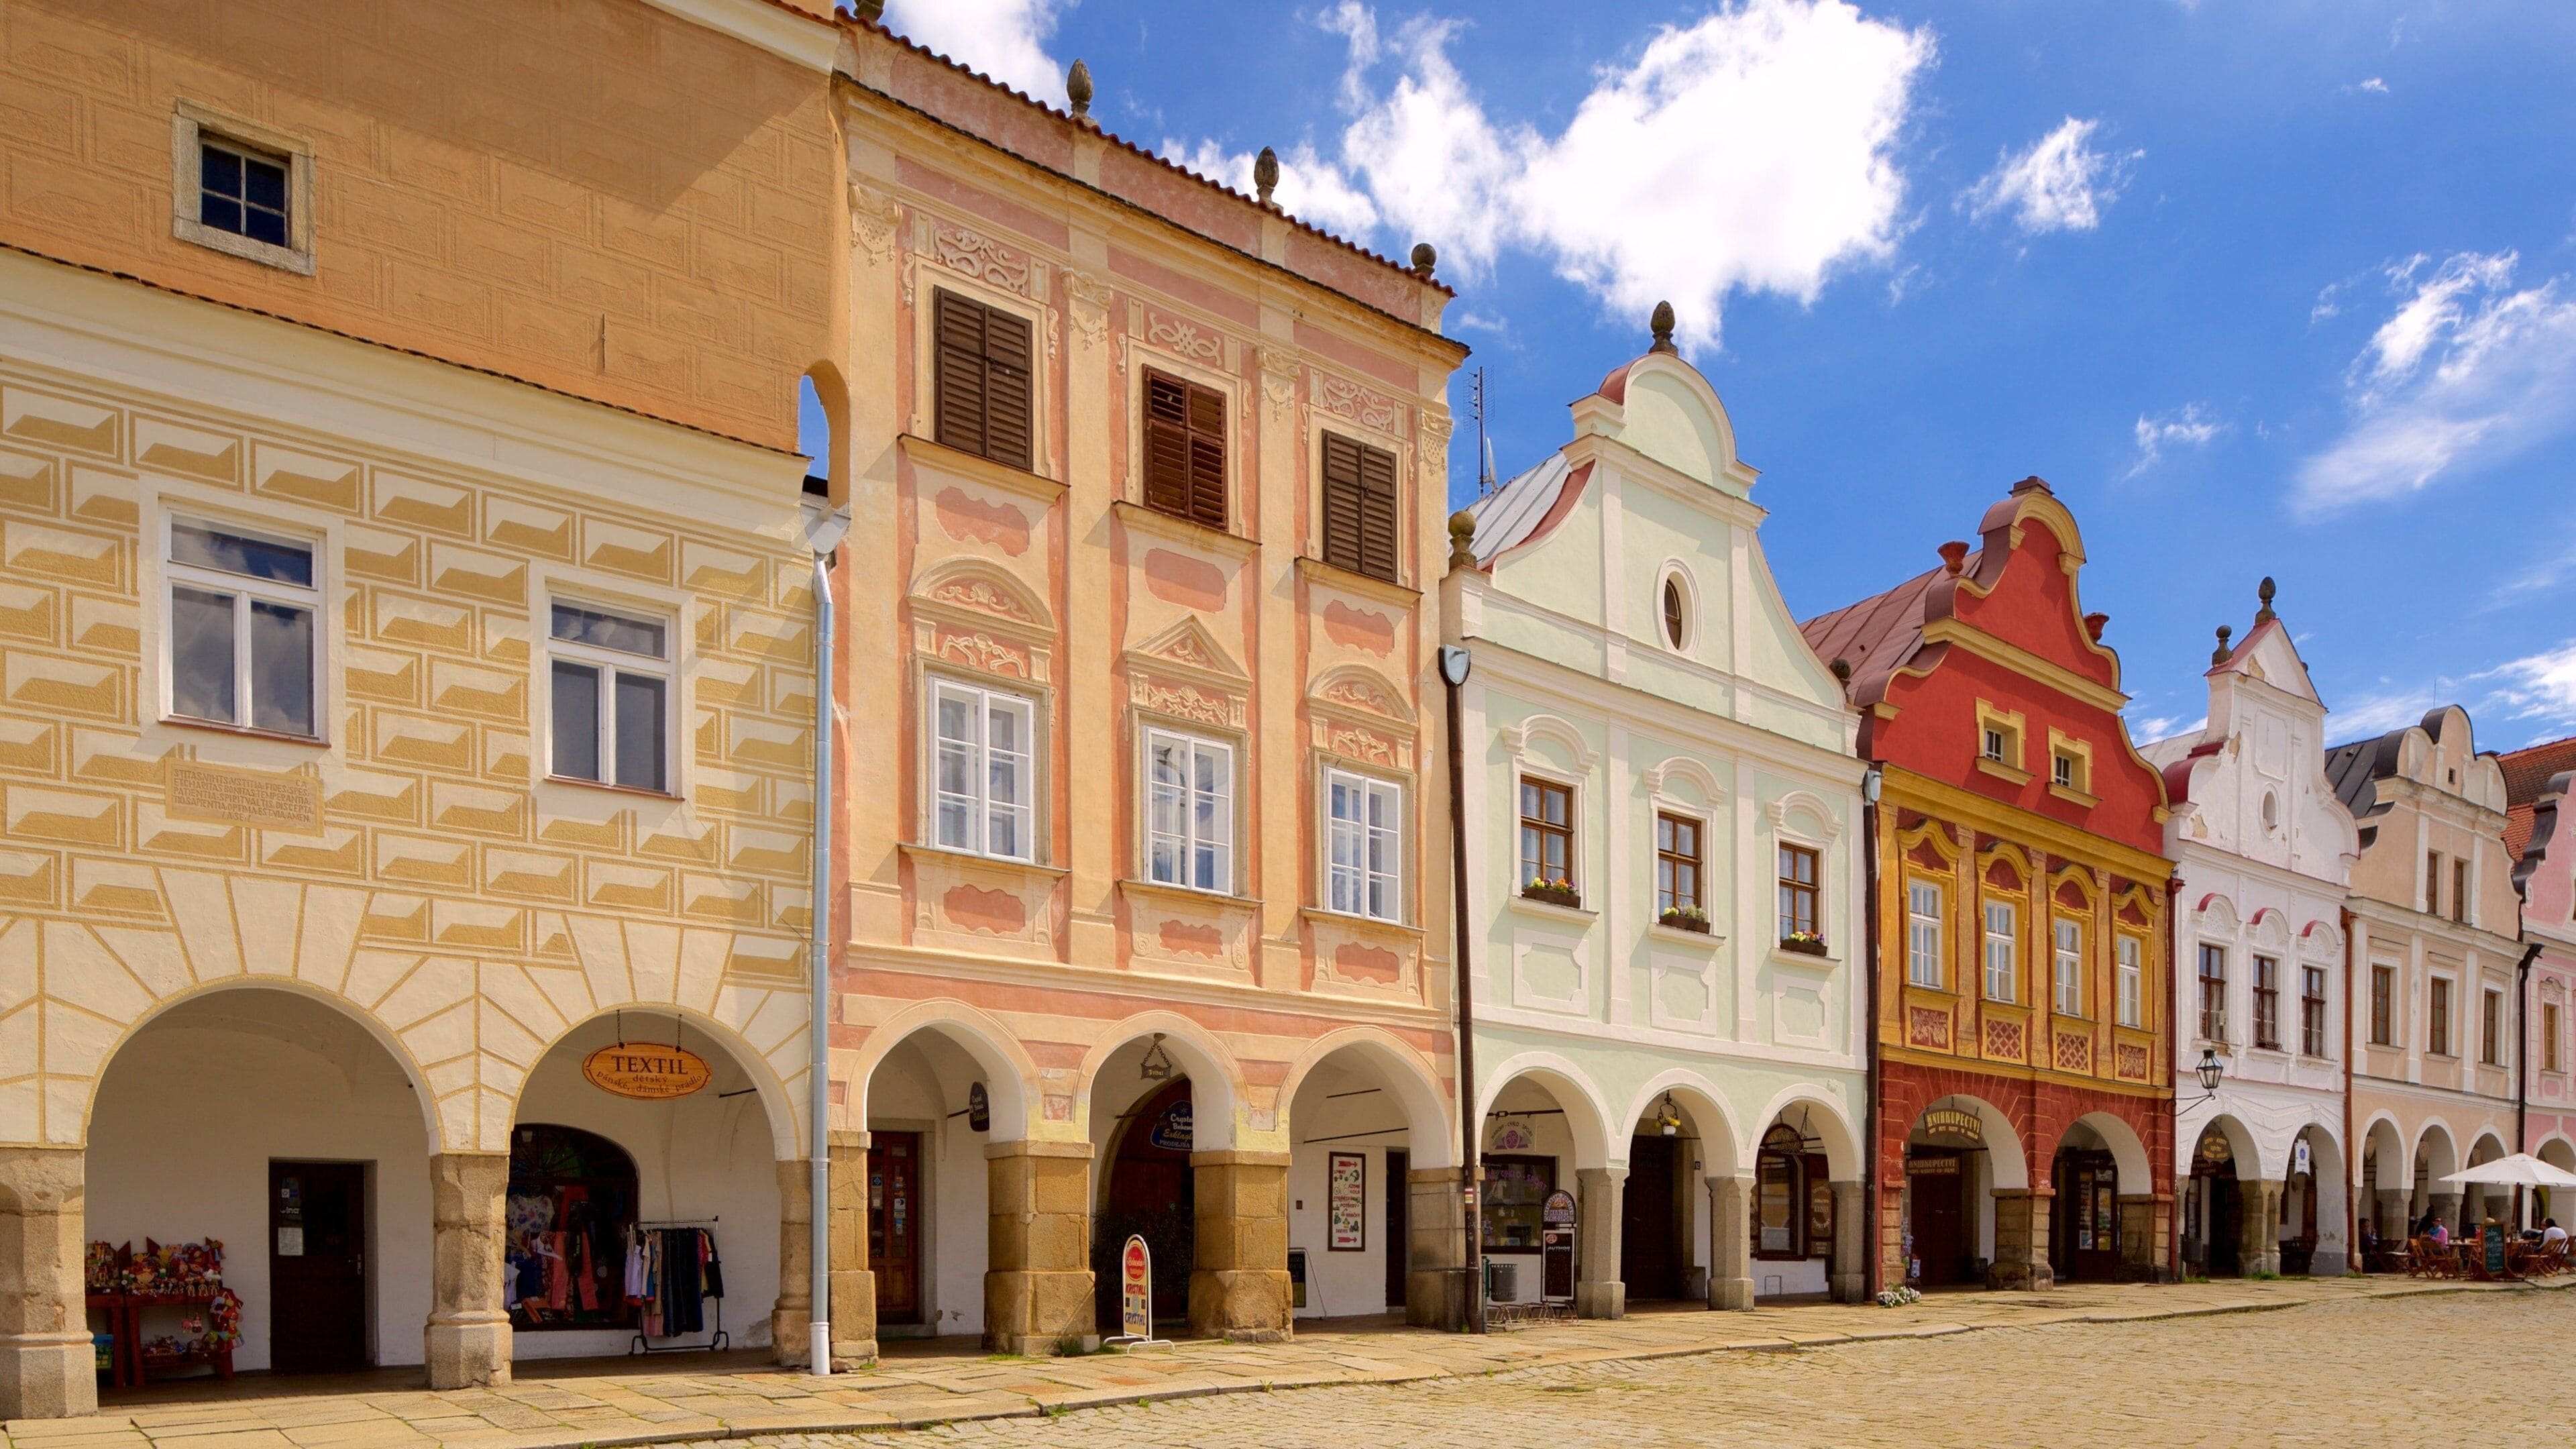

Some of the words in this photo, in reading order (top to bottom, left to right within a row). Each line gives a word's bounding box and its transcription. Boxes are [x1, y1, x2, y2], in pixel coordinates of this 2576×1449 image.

[611, 1056, 688, 1075] TEXTIL
[633, 1075, 668, 1084] dětský
[676, 1075, 702, 1092] prádlo
[1927, 1110, 1983, 1134] KNIHKUPECTVÍ
[1126, 1283, 1146, 1295] KRISTALL
[1125, 1311, 1146, 1326] CRYSTAL
